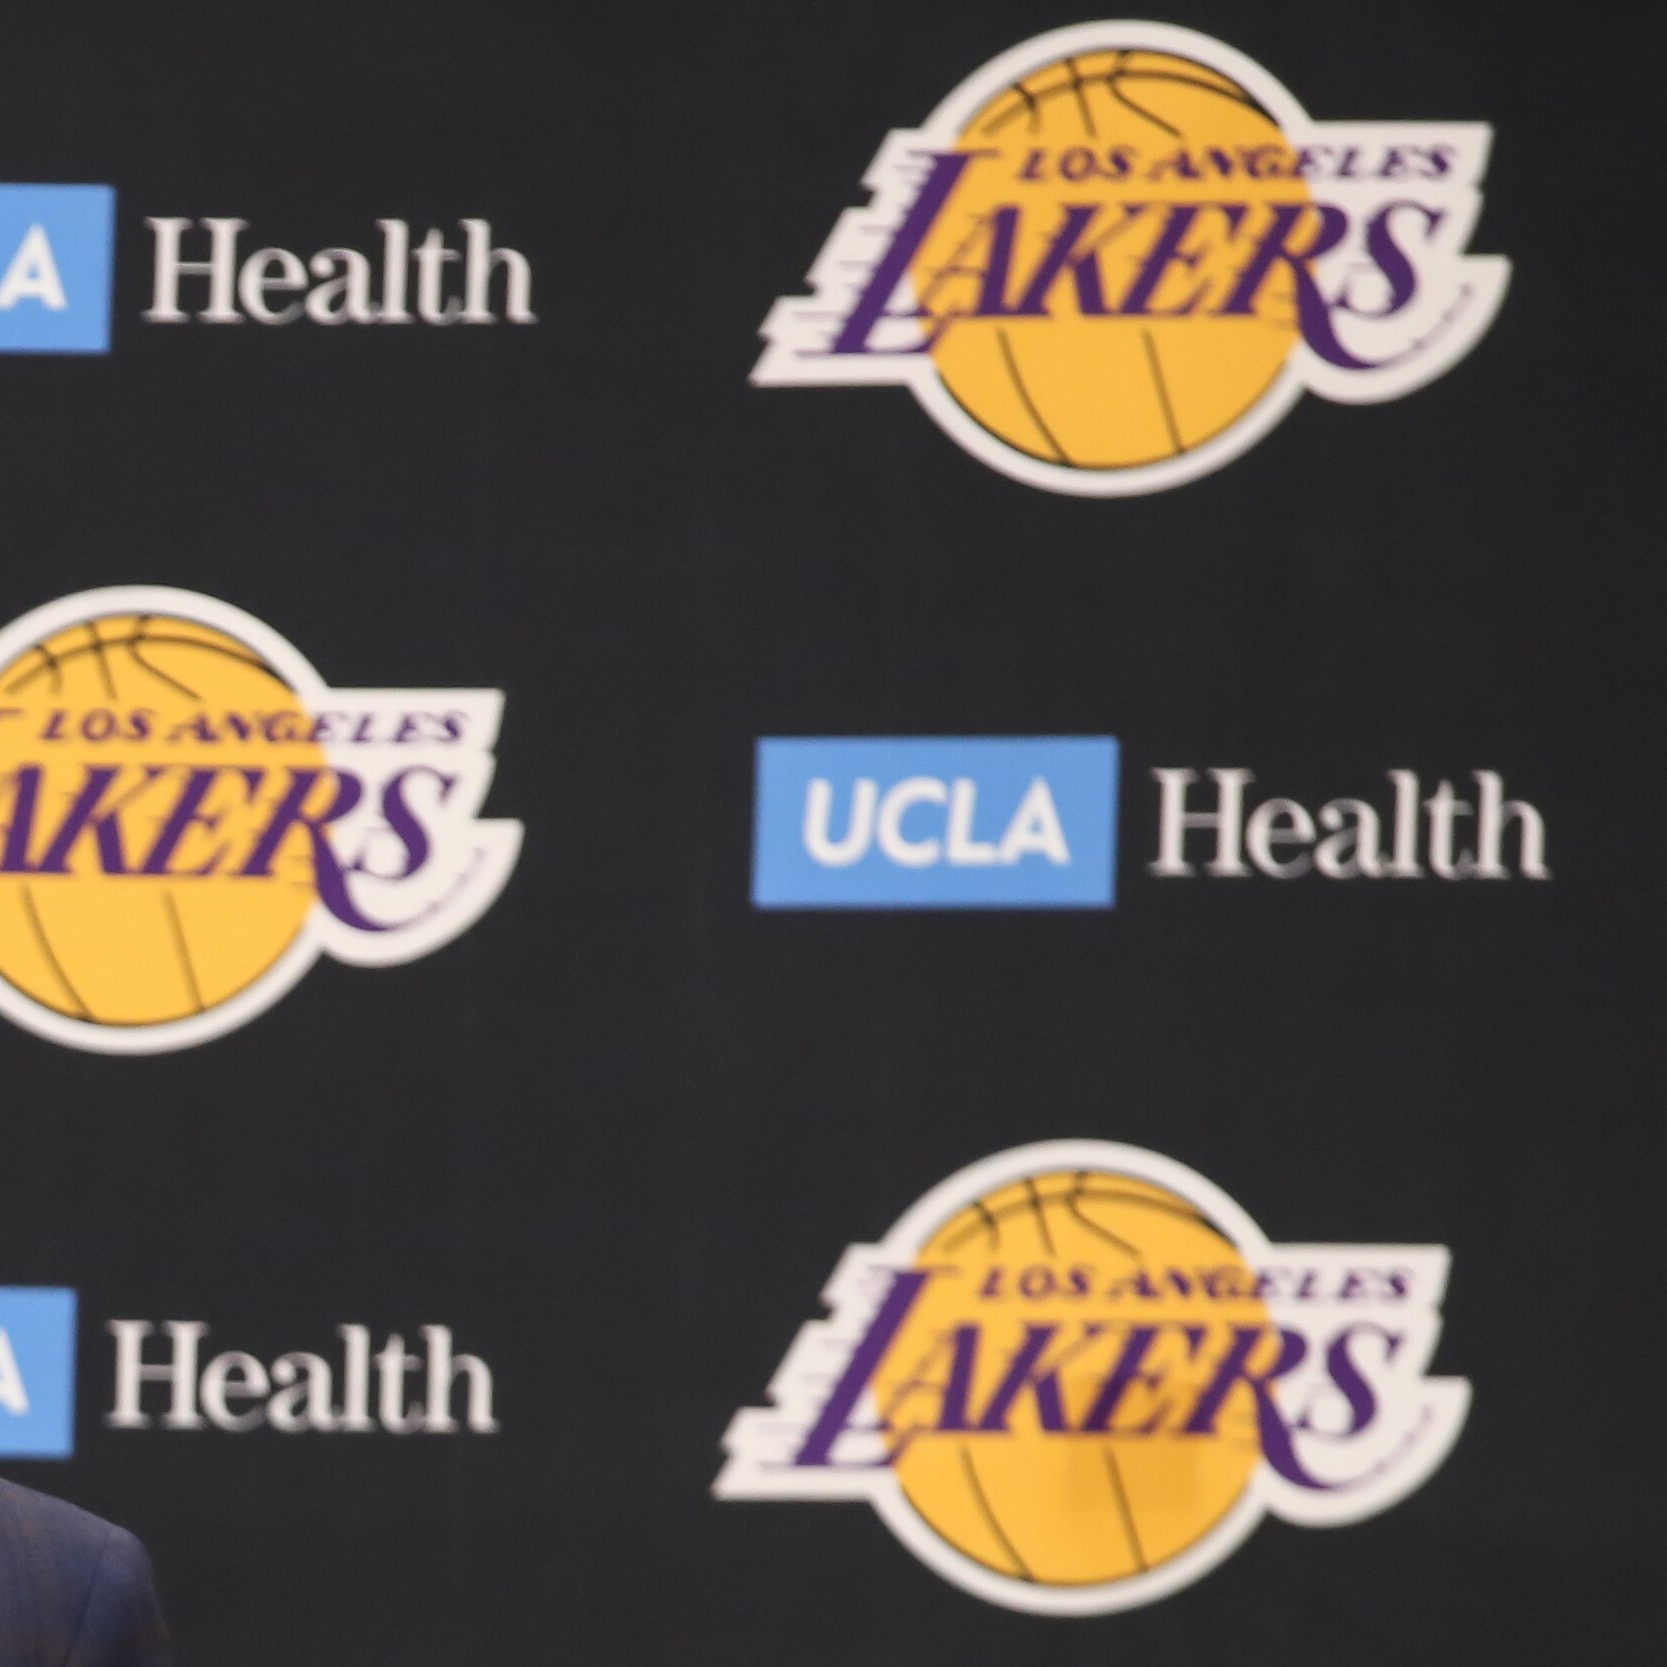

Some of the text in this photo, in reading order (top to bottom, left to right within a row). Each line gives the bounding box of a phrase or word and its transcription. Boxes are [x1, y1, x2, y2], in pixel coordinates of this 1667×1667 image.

[1018, 144, 1456, 182] LOS ANGELES
[144, 217, 535, 325] Health
[806, 146, 1473, 372] LAKERS
[39, 708, 469, 745] LOS ANGELES
[802, 768, 1547, 879] UCLA Health
[977, 1265, 1415, 1302] LOS ANGELES
[108, 1320, 496, 1434] Health
[767, 1265, 1433, 1492] LAKERS
